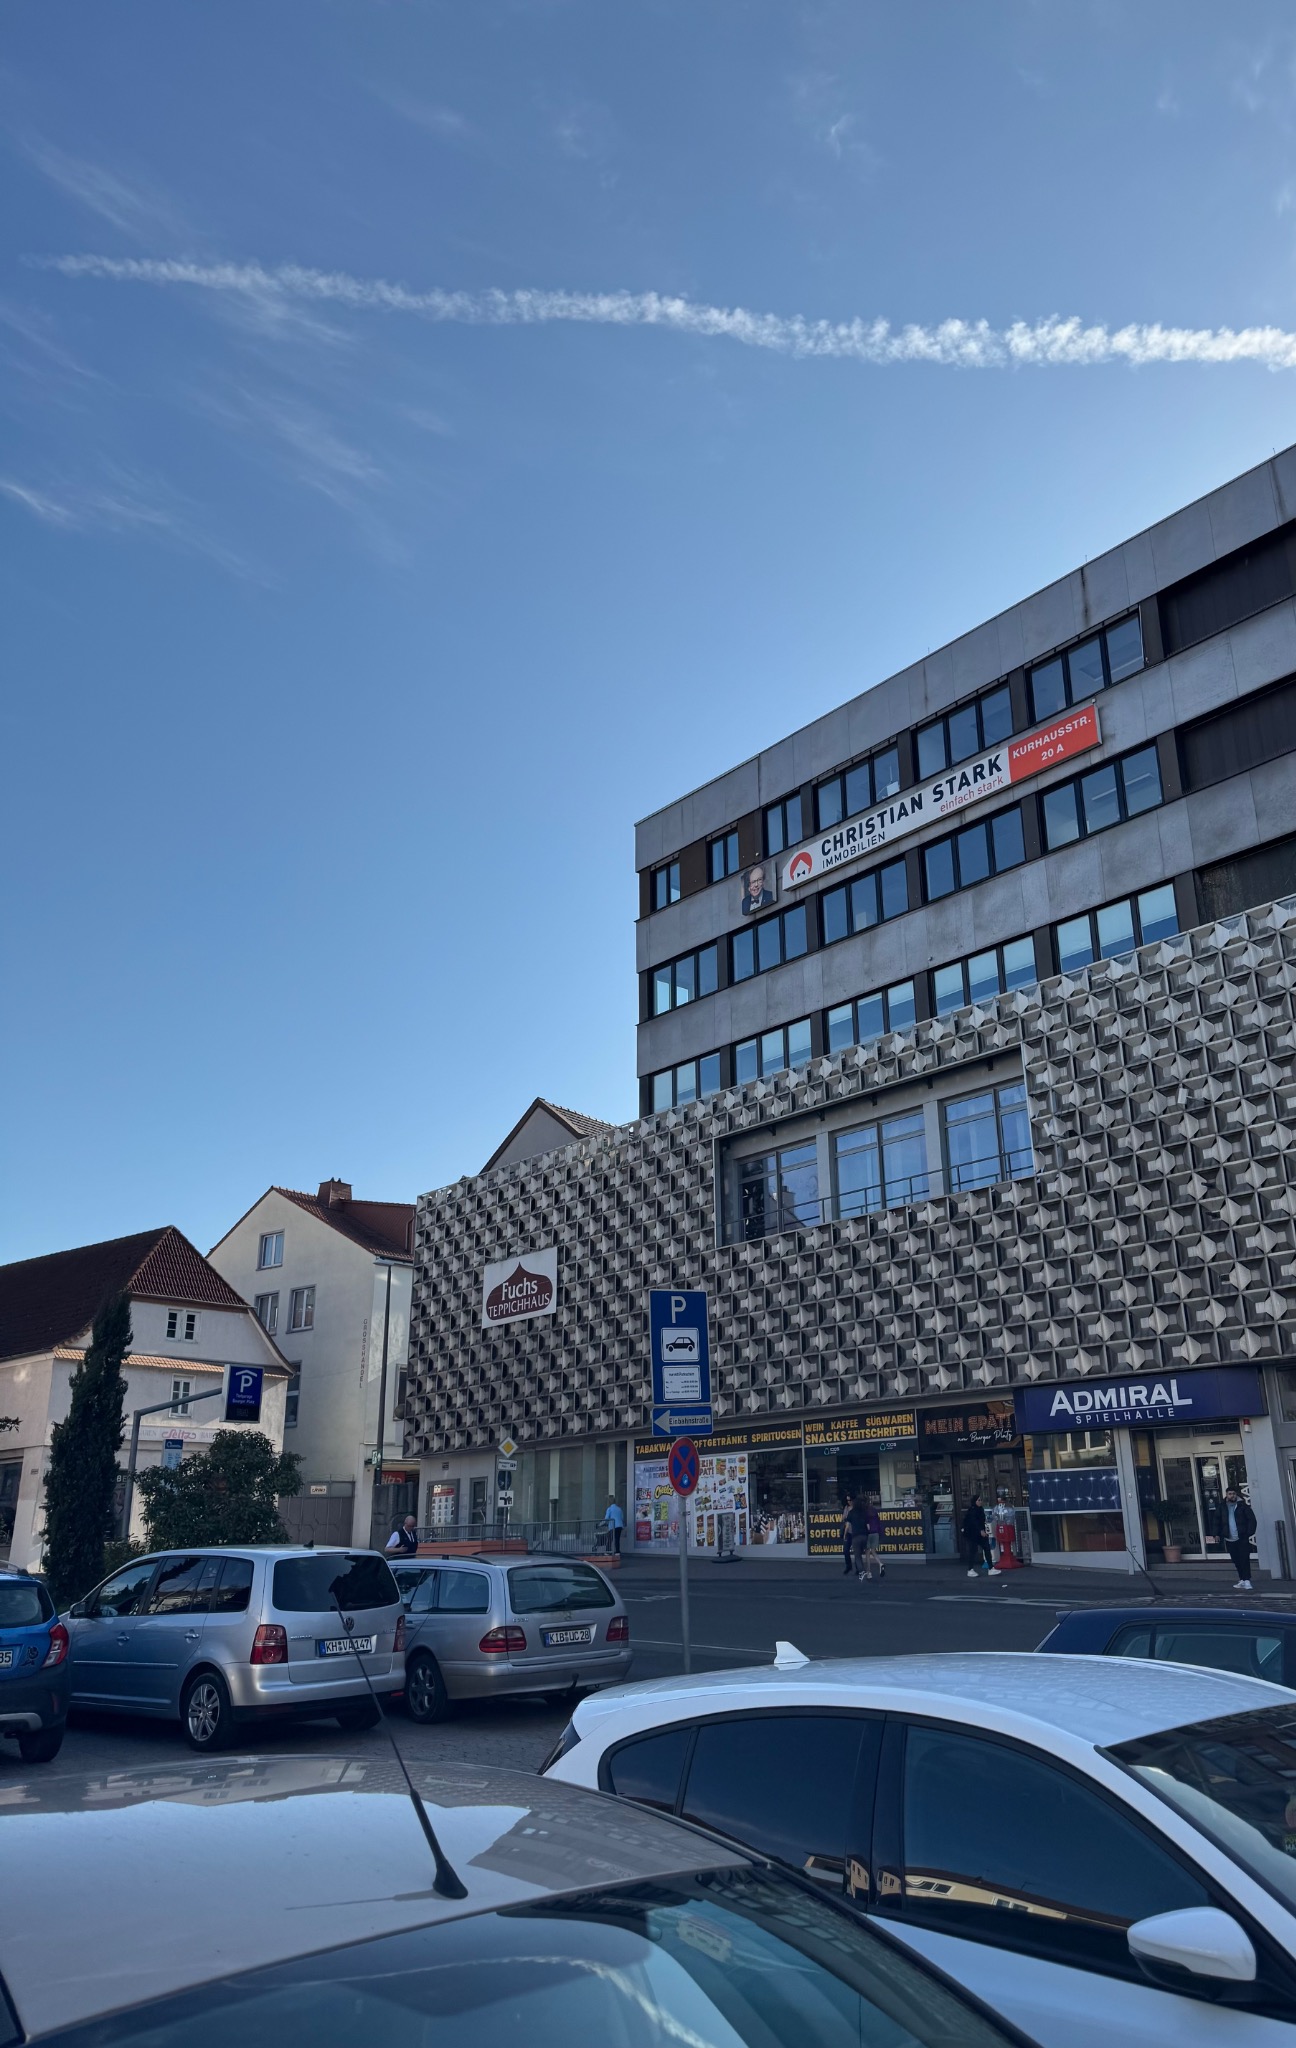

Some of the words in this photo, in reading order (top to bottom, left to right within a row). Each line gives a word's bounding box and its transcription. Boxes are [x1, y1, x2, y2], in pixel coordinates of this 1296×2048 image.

[1012, 716, 1091, 759] KURHAUSSTR.
[1041, 748, 1054, 761] 20
[1056, 743, 1064, 754] A
[940, 790, 975, 812] einfach
[977, 775, 1004, 795] stark
[821, 793, 923, 856] CHRISTIAN
[933, 754, 1002, 802] STARK
[822, 831, 886, 869] IMMOBILIEN
[502, 1277, 538, 1301] Fuchs
[488, 1293, 550, 1318] TEPPICHHAUS
[671, 1296, 686, 1324] P
[360, 1318, 368, 1389] GROSSHANDEL
[240, 1375, 253, 1393] P
[1050, 1379, 1193, 1416] ADMIRAL
[669, 1416, 709, 1425] Einbahnstraße
[1075, 1408, 1175, 1424] SPIELHALLE
[805, 1422, 824, 1433] WEIN
[831, 1419, 858, 1430] KAFFEE
[805, 1431, 847, 1444] SNACKS
[848, 1425, 915, 1440] ZEITSCHRIFTEN
[925, 1417, 963, 1434] MEIN
[636, 1442, 671, 1454] TABAKWA
[694, 1434, 748, 1447] OFTGETRÄNKE
[751, 1429, 801, 1443] SPIRITUOSEN
[809, 1514, 843, 1523] TABAKW
[878, 1511, 922, 1520] IRITUOSEN
[885, 1526, 923, 1536] SNACKS
[899, 1543, 924, 1551] KAFFEE
[326, 1641, 339, 1652] KH
[355, 1638, 369, 1650] 147
[549, 1633, 565, 1643] KIB
[569, 1631, 579, 1641] UC
[580, 1630, 590, 1641] 28
